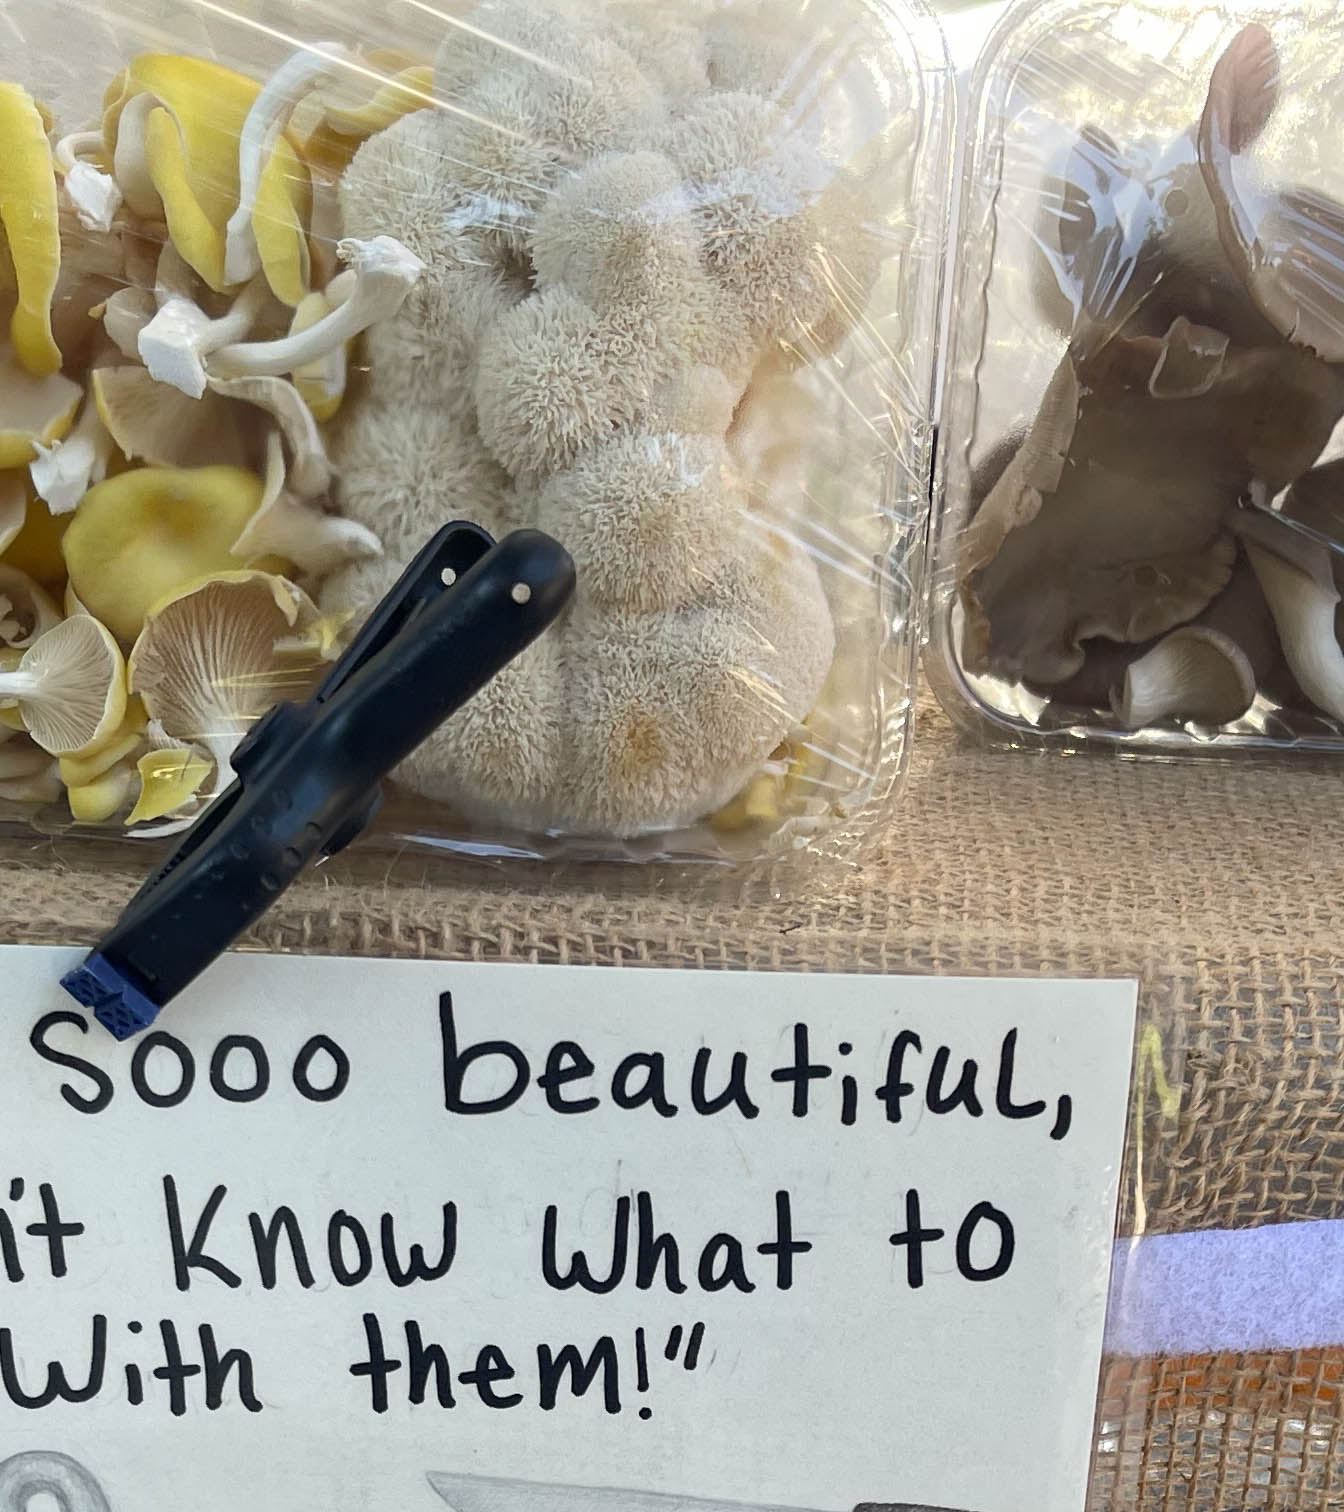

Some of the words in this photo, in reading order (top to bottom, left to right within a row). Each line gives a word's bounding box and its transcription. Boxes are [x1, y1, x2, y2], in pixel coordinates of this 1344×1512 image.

[438, 990, 1072, 1141] beautiful,
[888, 1188, 1016, 1289] to
[349, 1312, 706, 1421] them!"
